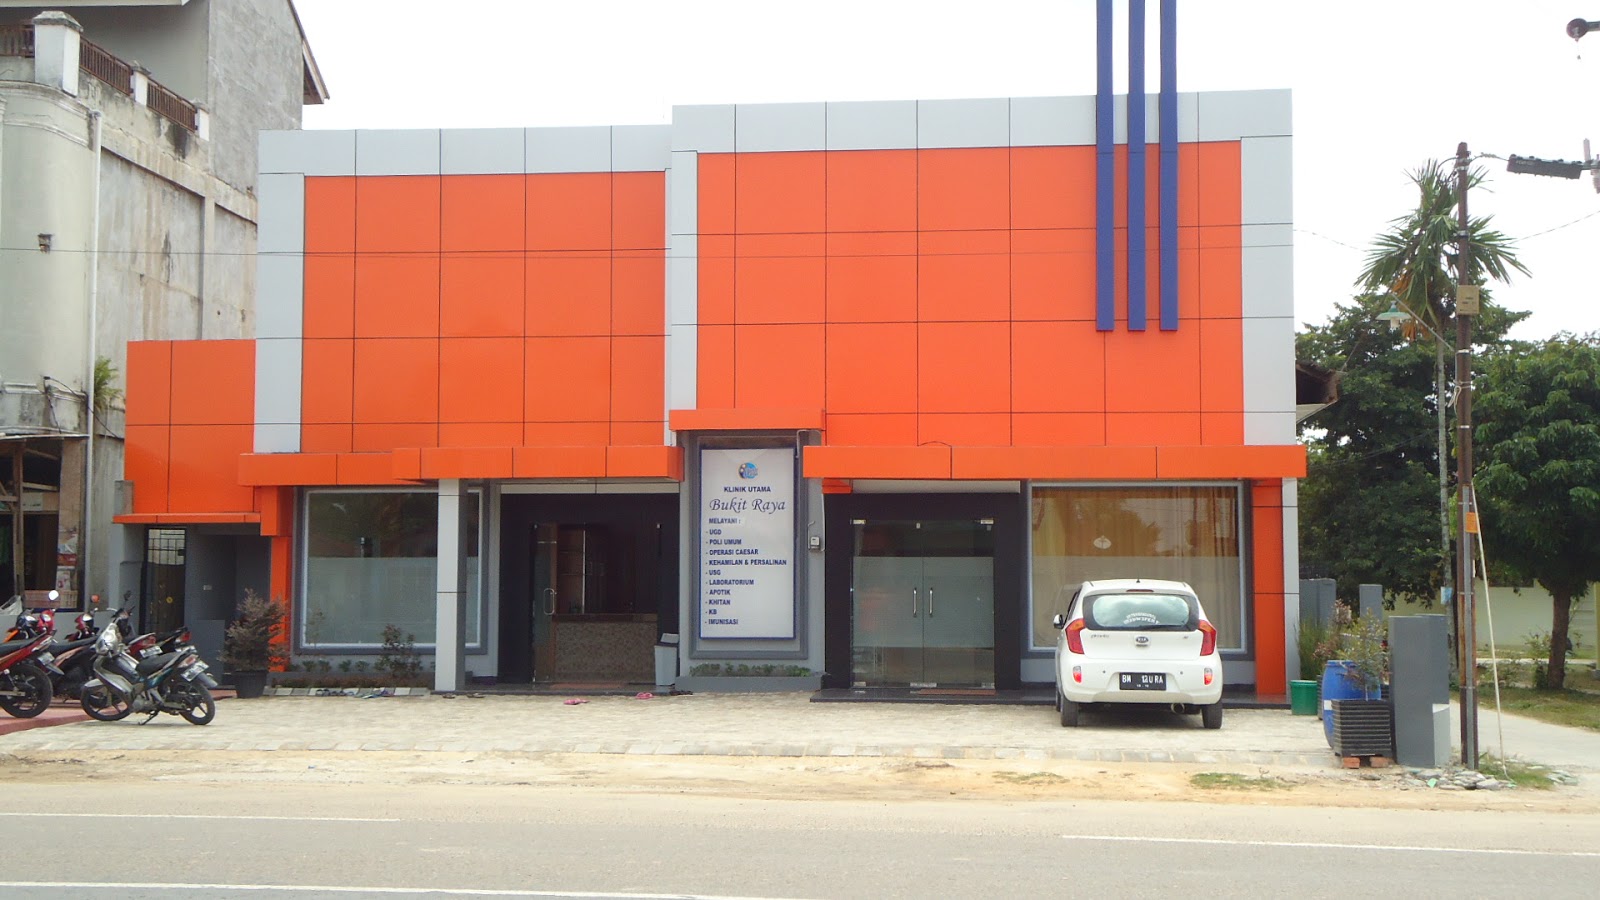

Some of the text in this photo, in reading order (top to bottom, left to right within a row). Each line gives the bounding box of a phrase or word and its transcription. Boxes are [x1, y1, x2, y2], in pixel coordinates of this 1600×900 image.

[709, 497, 786, 514] Bukit Raya
[1122, 674, 1132, 683] BM
